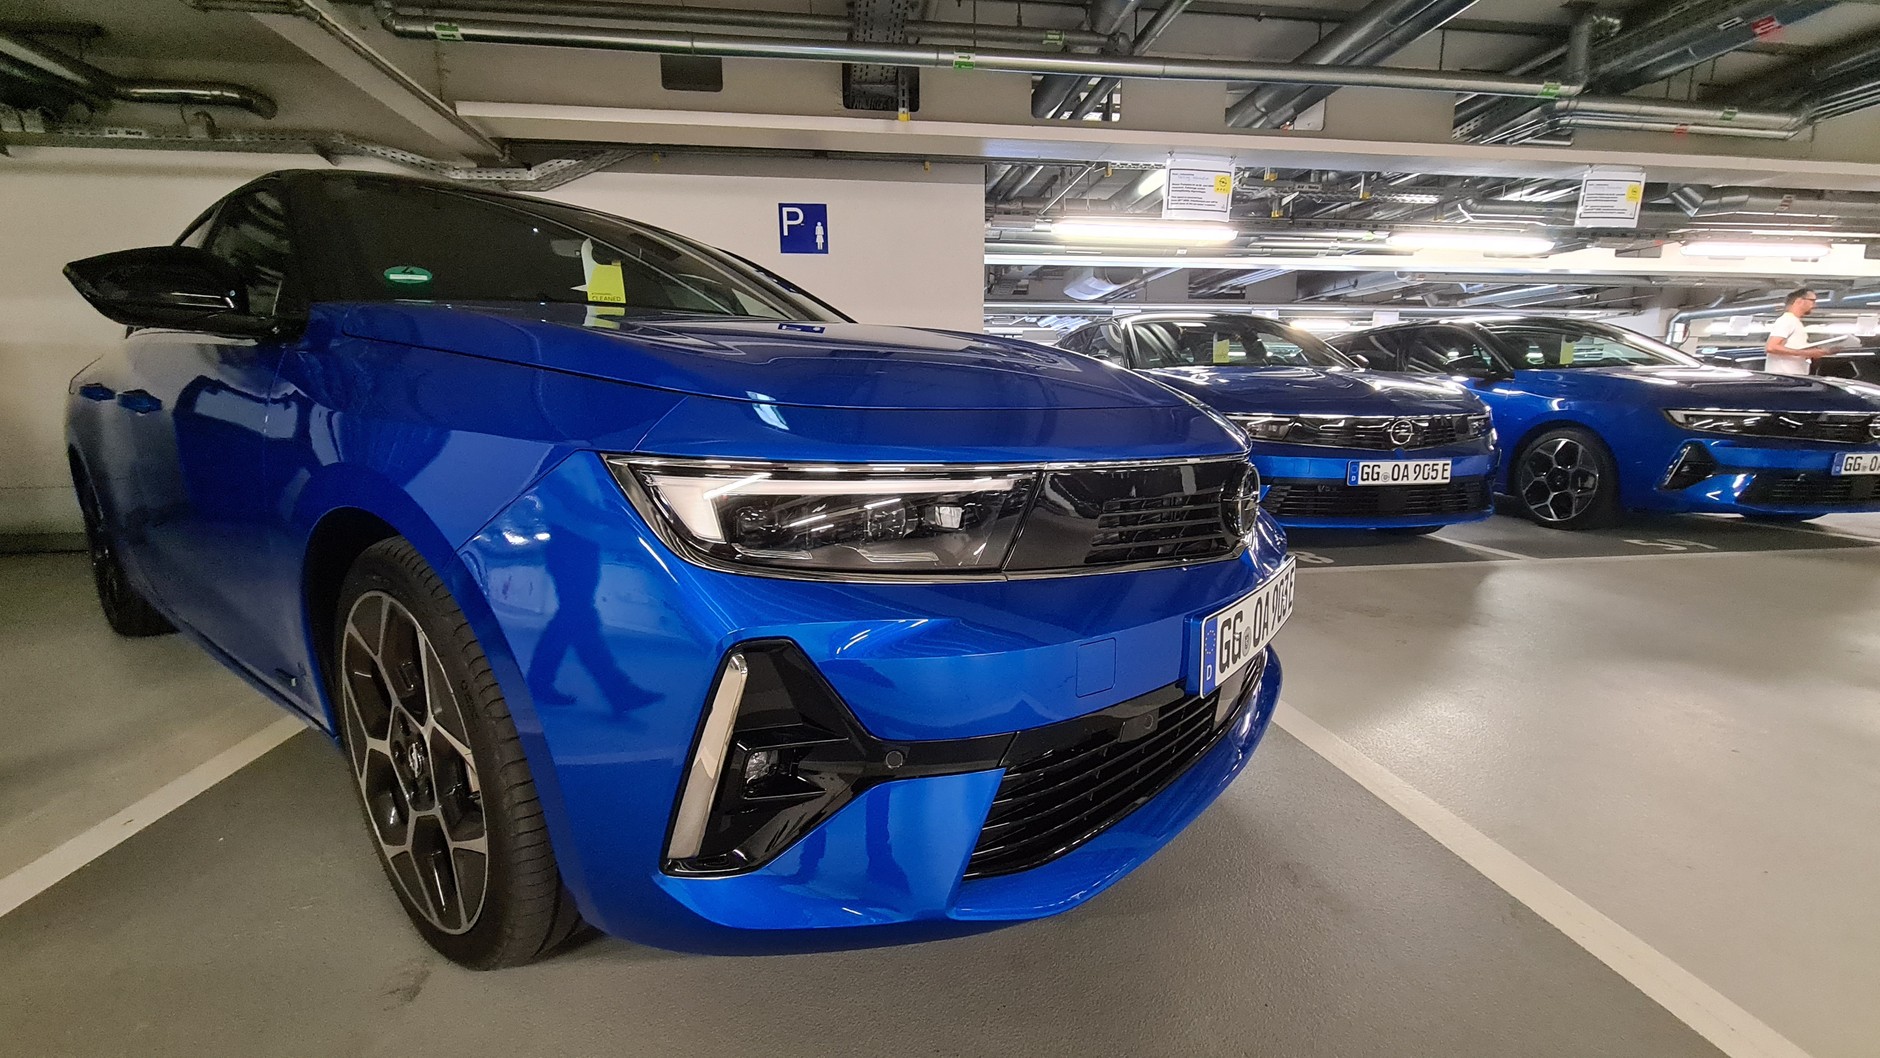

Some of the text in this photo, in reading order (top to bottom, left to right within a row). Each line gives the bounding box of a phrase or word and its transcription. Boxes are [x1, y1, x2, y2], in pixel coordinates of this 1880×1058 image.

[782, 207, 804, 236] P
[1361, 464, 1380, 481] GG
[1391, 463, 1409, 481] OA
[1844, 456, 1862, 471] GG
[1206, 665, 1212, 681] D
[1219, 610, 1243, 674] GG
[1252, 590, 1270, 648] OA
